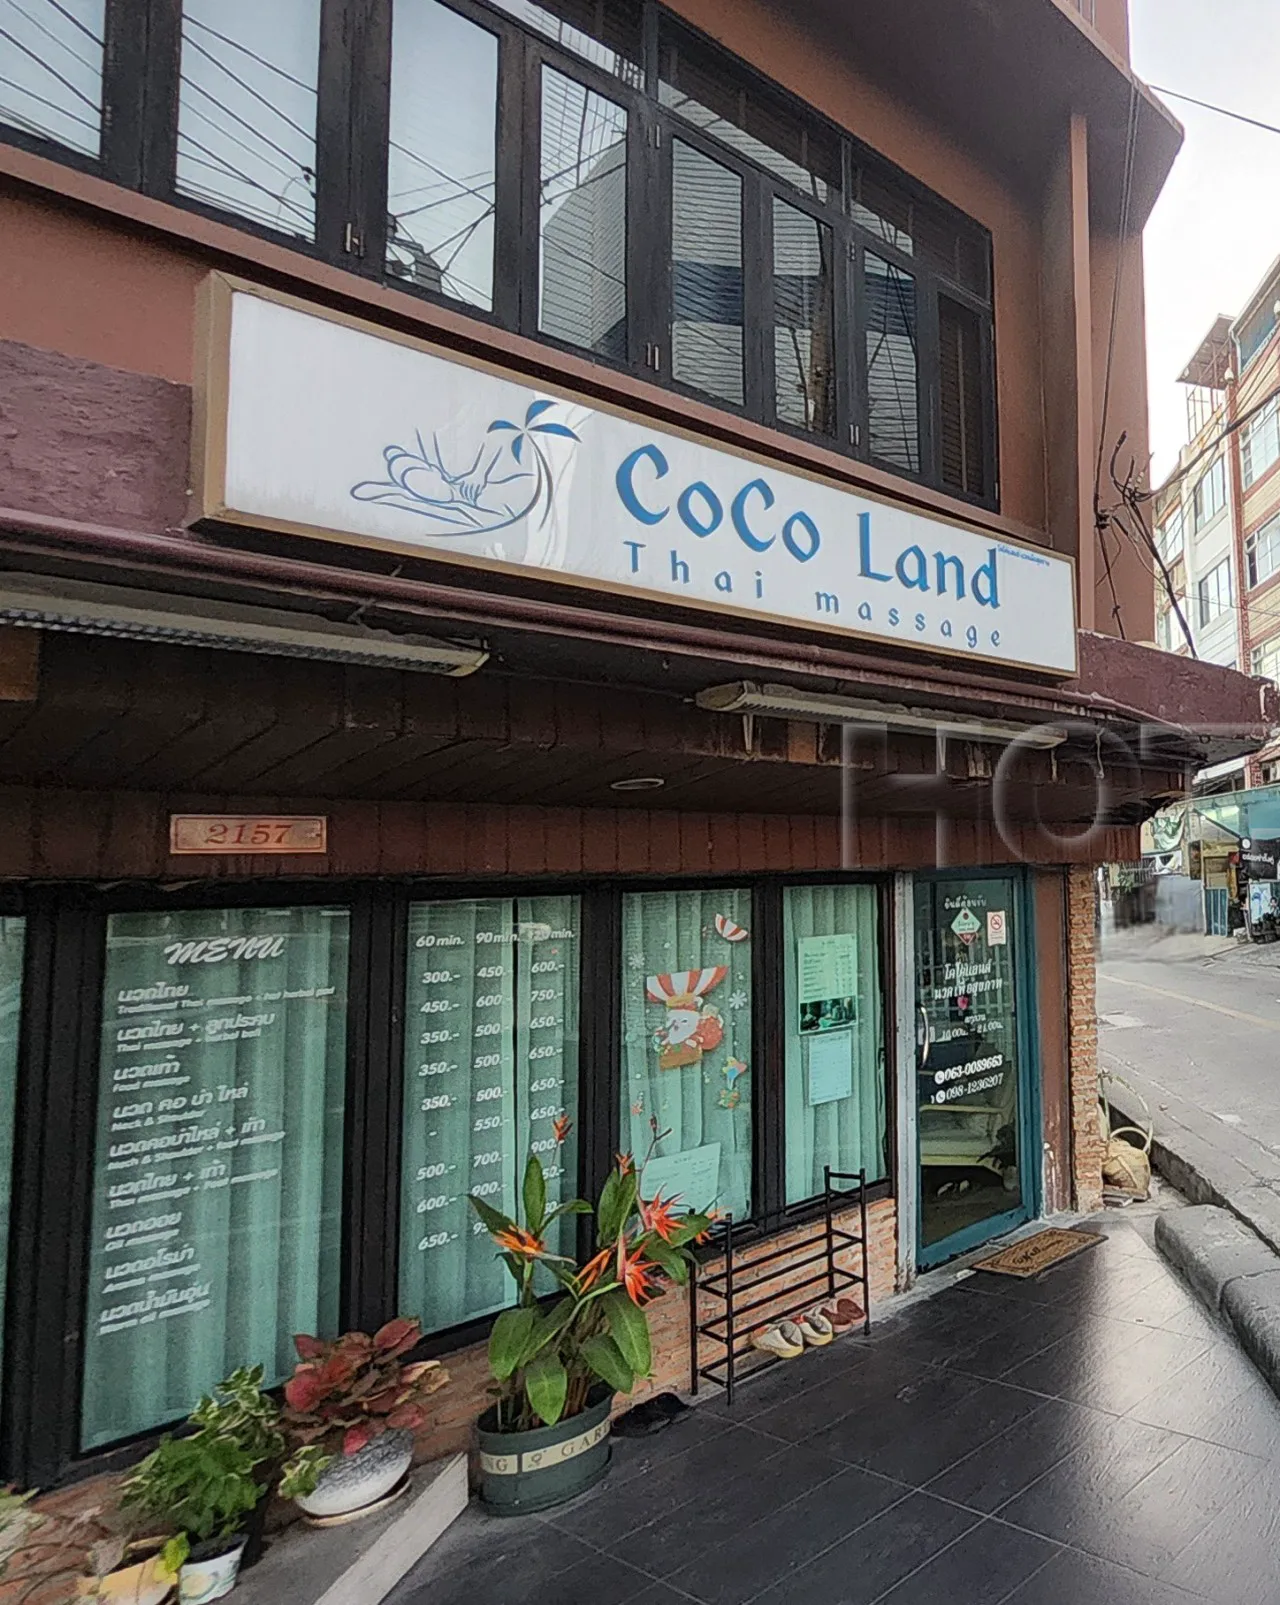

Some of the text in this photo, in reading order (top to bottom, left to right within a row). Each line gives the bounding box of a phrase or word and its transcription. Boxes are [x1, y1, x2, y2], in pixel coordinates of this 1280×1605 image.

[616, 444, 1001, 609] CoCo Land
[623, 541, 1001, 648] Thai massage
[204, 823, 293, 844] 2157
[416, 935, 435, 947] 60
[436, 935, 466, 946] min.
[475, 932, 493, 944] 90
[551, 928, 575, 939] min.
[164, 935, 286, 965] MENU
[422, 971, 461, 984] 300.-
[531, 962, 565, 974] 600.-
[420, 1000, 461, 1013] 450.-
[531, 990, 564, 1002] 750.-
[420, 1030, 460, 1044] 350.-
[530, 1016, 564, 1029] 650.-
[418, 1062, 458, 1077] 350.-
[529, 1046, 563, 1060] 650.-
[421, 1095, 457, 1111] 350.-
[530, 1078, 565, 1093] 650.-
[530, 1105, 565, 1120] 650.-
[416, 1163, 456, 1181] 500.-
[416, 1195, 457, 1213] 600.-
[418, 1231, 458, 1251] 650.-
